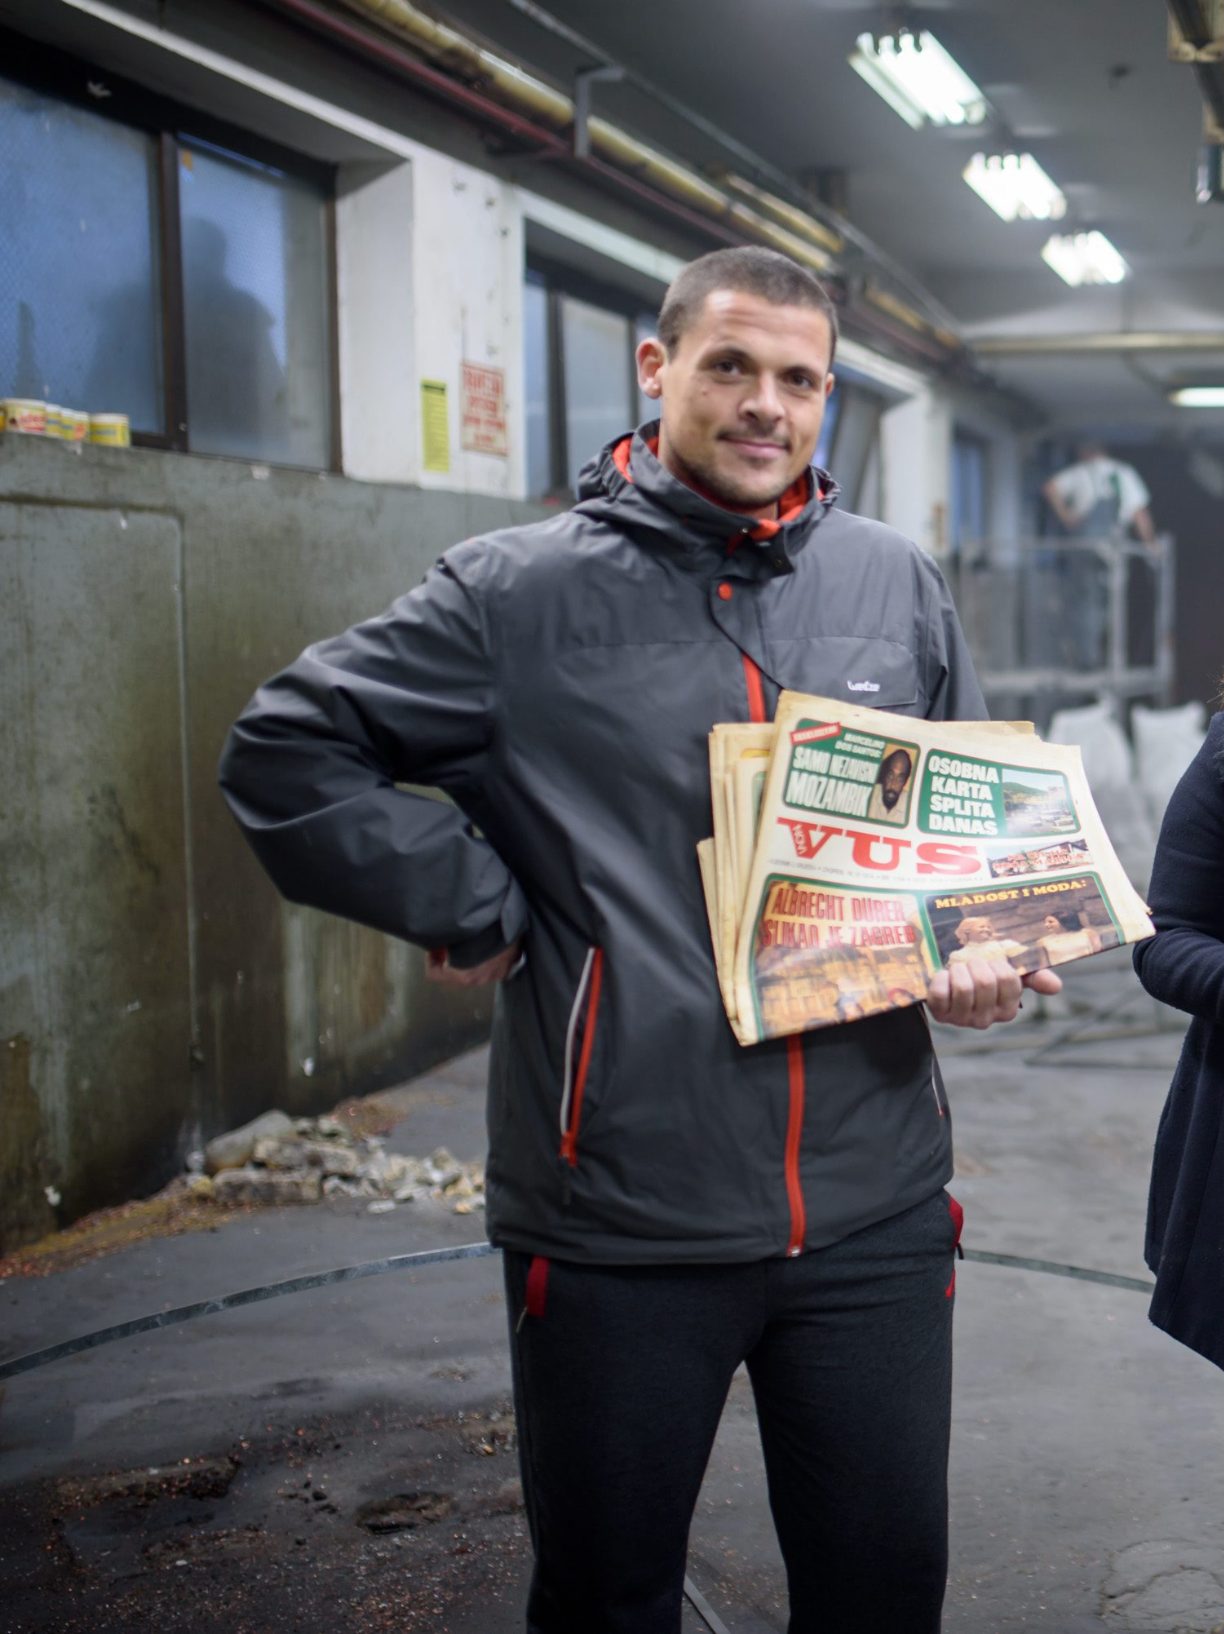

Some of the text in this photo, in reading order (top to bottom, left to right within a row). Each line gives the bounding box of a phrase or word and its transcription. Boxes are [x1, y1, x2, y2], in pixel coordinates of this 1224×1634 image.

[928, 755, 1000, 783] OSOBNA
[931, 775, 993, 801] KARTA
[930, 794, 996, 818] SPLITA
[929, 813, 998, 835] DANAS
[777, 816, 982, 875] VUS
[773, 887, 845, 921] ALBRECHT
[935, 890, 1018, 909] MLADOST
[849, 924, 917, 949] ZAGREB
